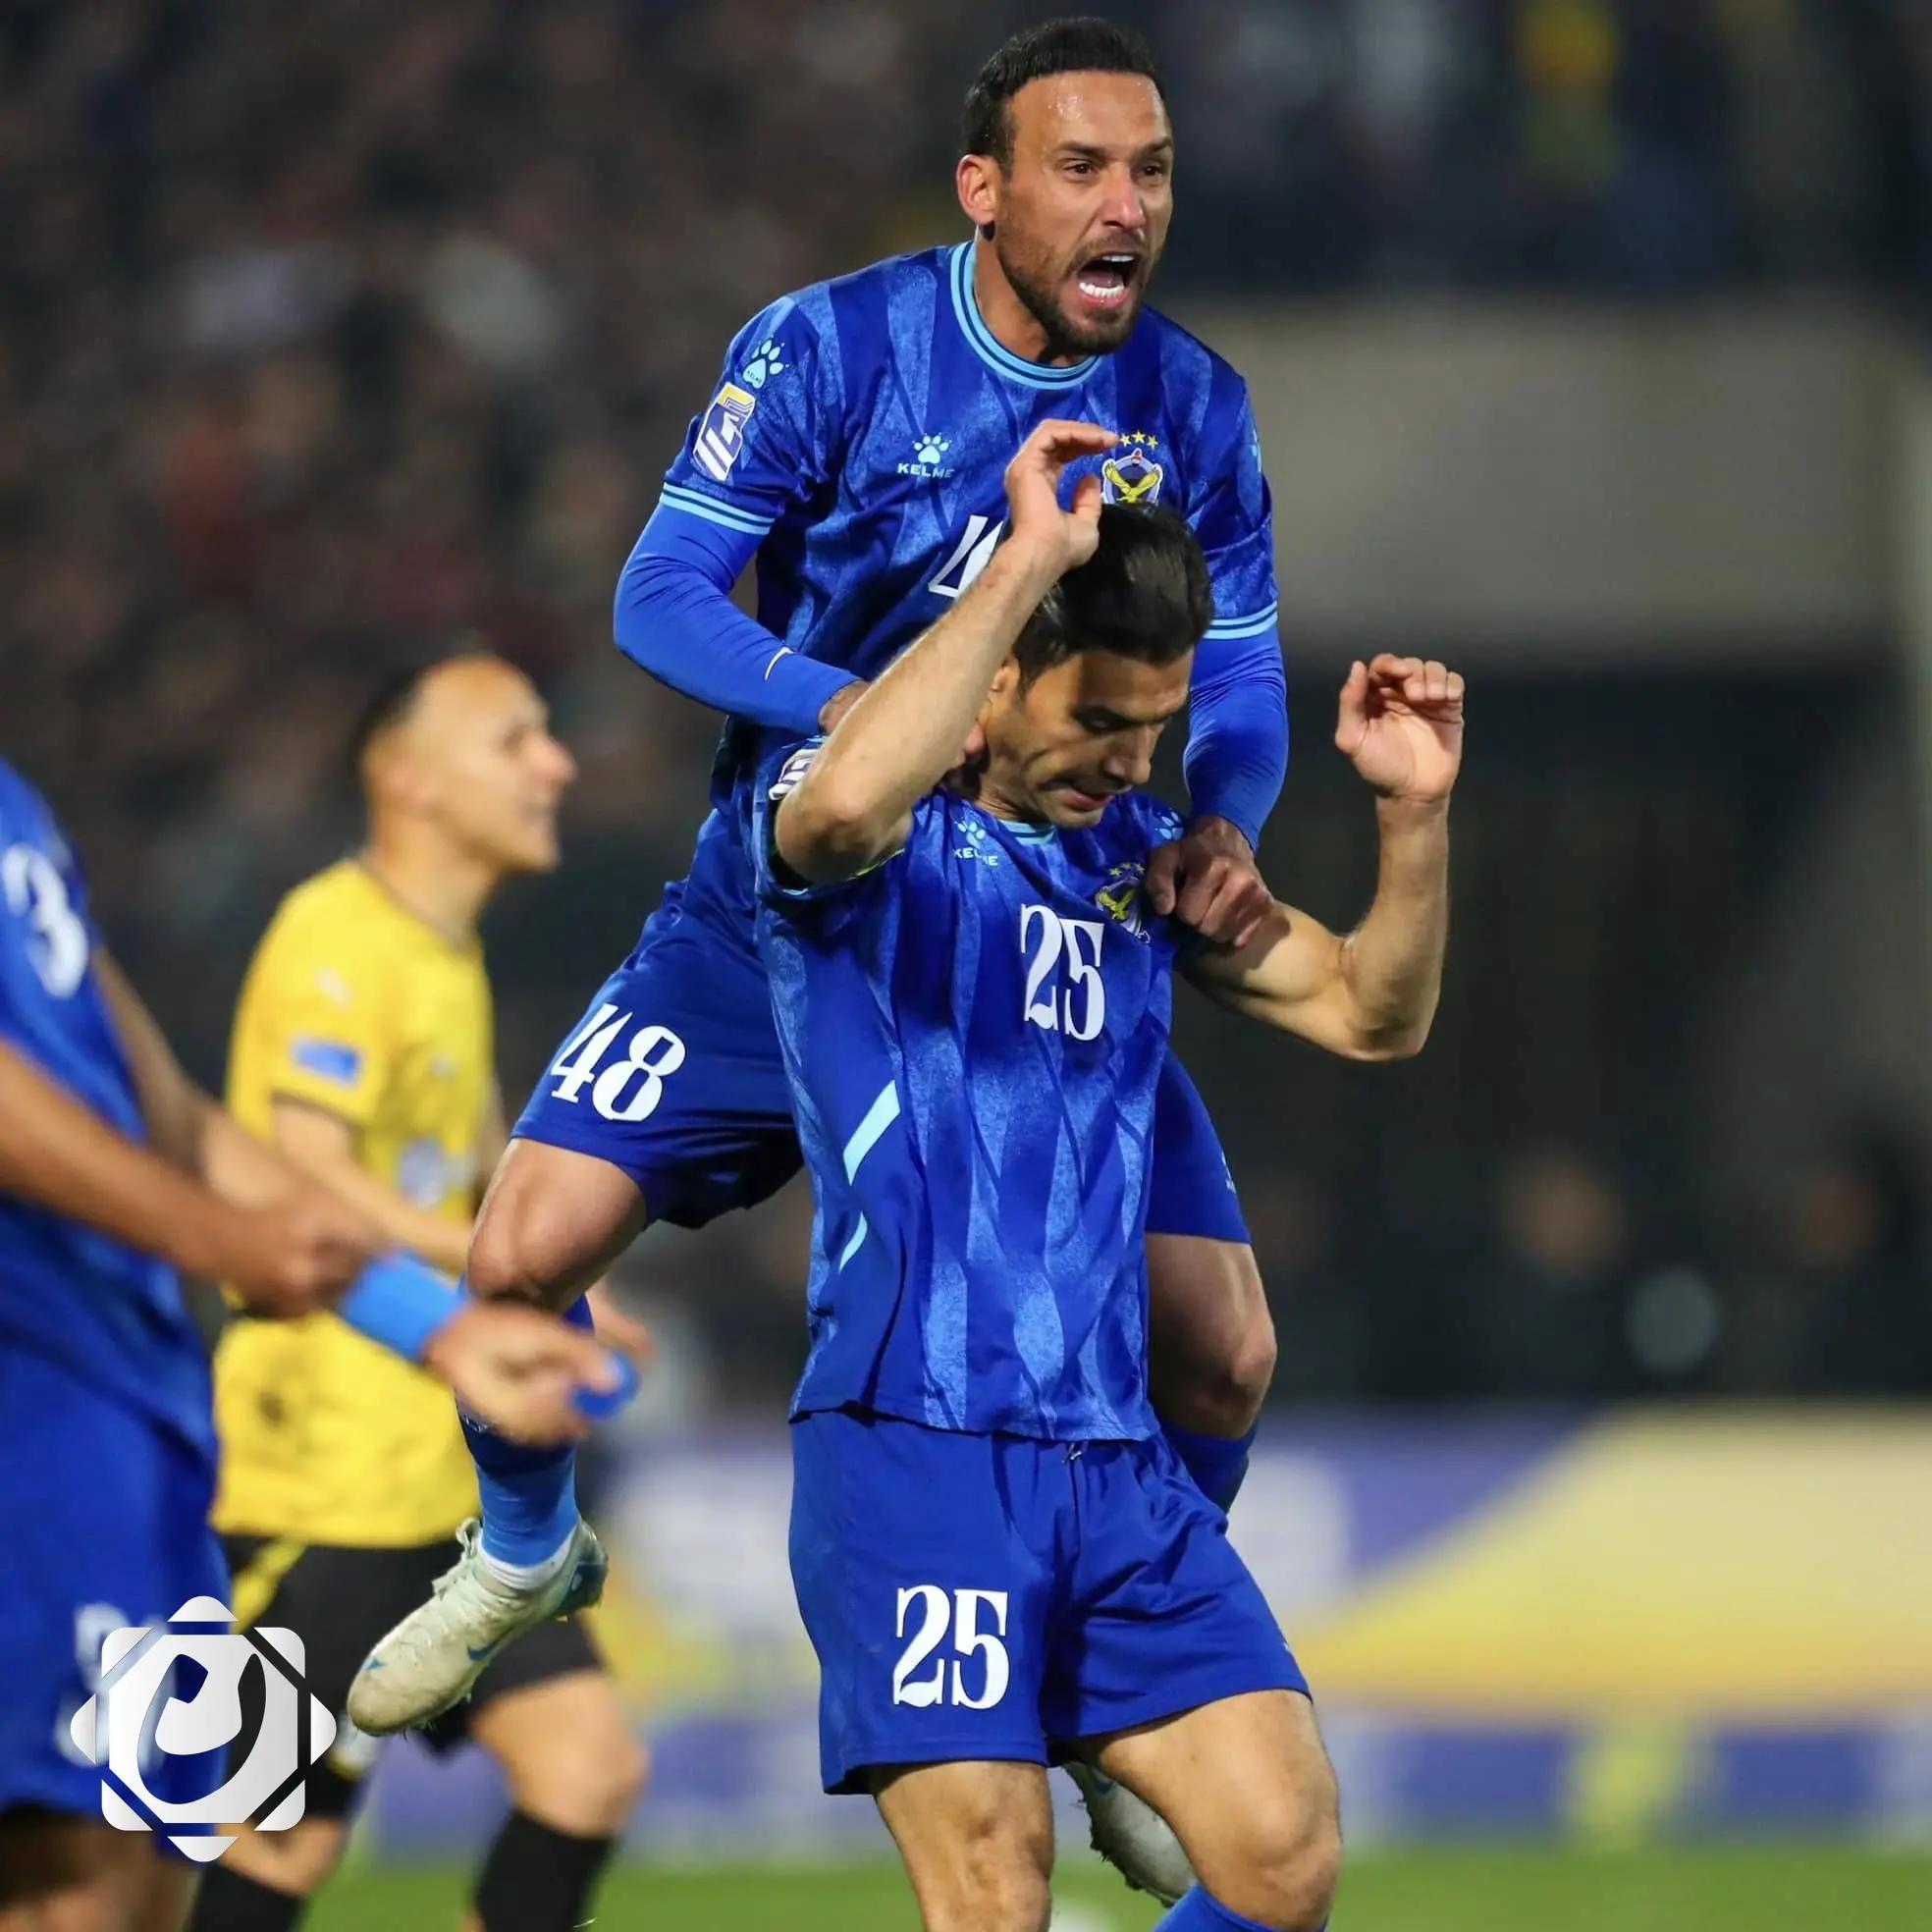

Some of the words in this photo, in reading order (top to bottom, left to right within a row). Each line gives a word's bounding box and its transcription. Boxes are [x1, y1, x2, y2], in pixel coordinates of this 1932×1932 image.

[897, 462, 955, 479] KELME
[1020, 903, 1105, 1042] 25
[550, 1002, 686, 1122] 48
[892, 1583, 1010, 1709] 25
